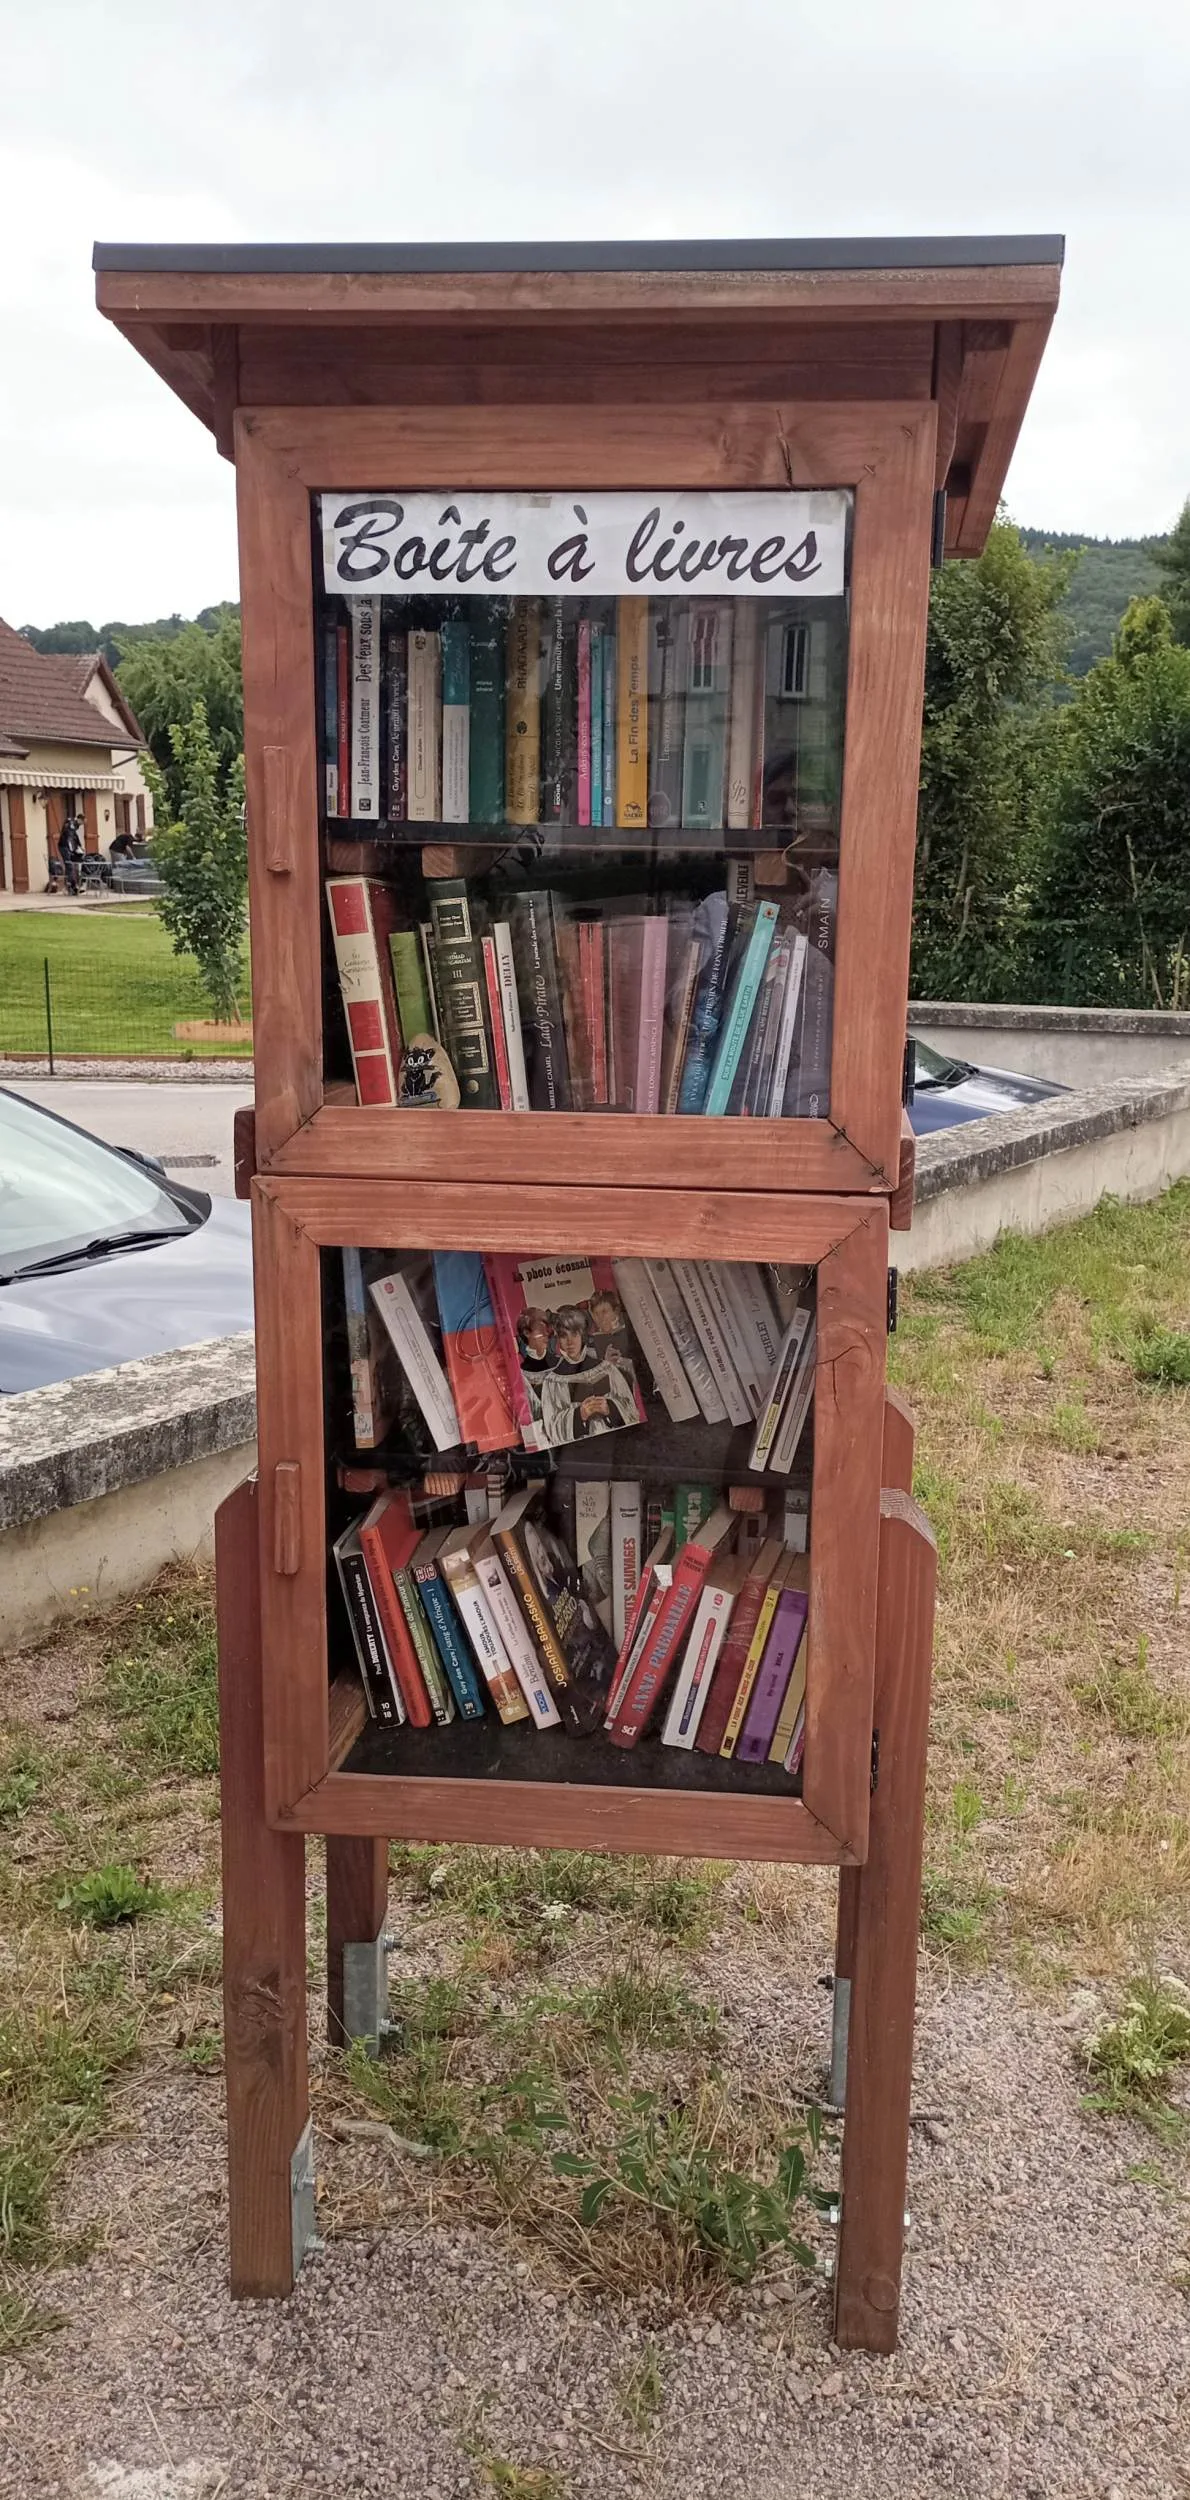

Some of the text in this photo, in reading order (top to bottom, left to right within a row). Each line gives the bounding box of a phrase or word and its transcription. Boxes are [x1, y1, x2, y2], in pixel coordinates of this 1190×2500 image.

[334, 500, 823, 583] Boîte à livres
[357, 612, 371, 634] sous
[555, 617, 564, 639] pour
[355, 638, 371, 659] feux
[553, 639, 562, 671] minute
[355, 663, 371, 682] Des
[553, 672, 562, 690] Une
[357, 698, 370, 733] Coatmeur
[628, 654, 639, 763] La Fin des Temps
[357, 735, 372, 785] Jean-François
[391, 761, 400, 775] des
[391, 775, 401, 791] Guy
[529, 972, 557, 1050] Lady Pirate
[524, 1262, 554, 1282] photo
[754, 1318, 779, 1367] MICHELET
[622, 1536, 637, 1591] SAUVAGES
[429, 1596, 449, 1632] d'Afrique
[521, 1590, 549, 1643] BALASKO
[441, 1630, 454, 1648] sang
[446, 1650, 460, 1668] Cars
[540, 1640, 568, 1690] JOSIANE
[452, 1666, 464, 1681] des
[456, 1679, 470, 1696] Guy
[380, 1701, 390, 1710] 10
[383, 1709, 392, 1719] 18
